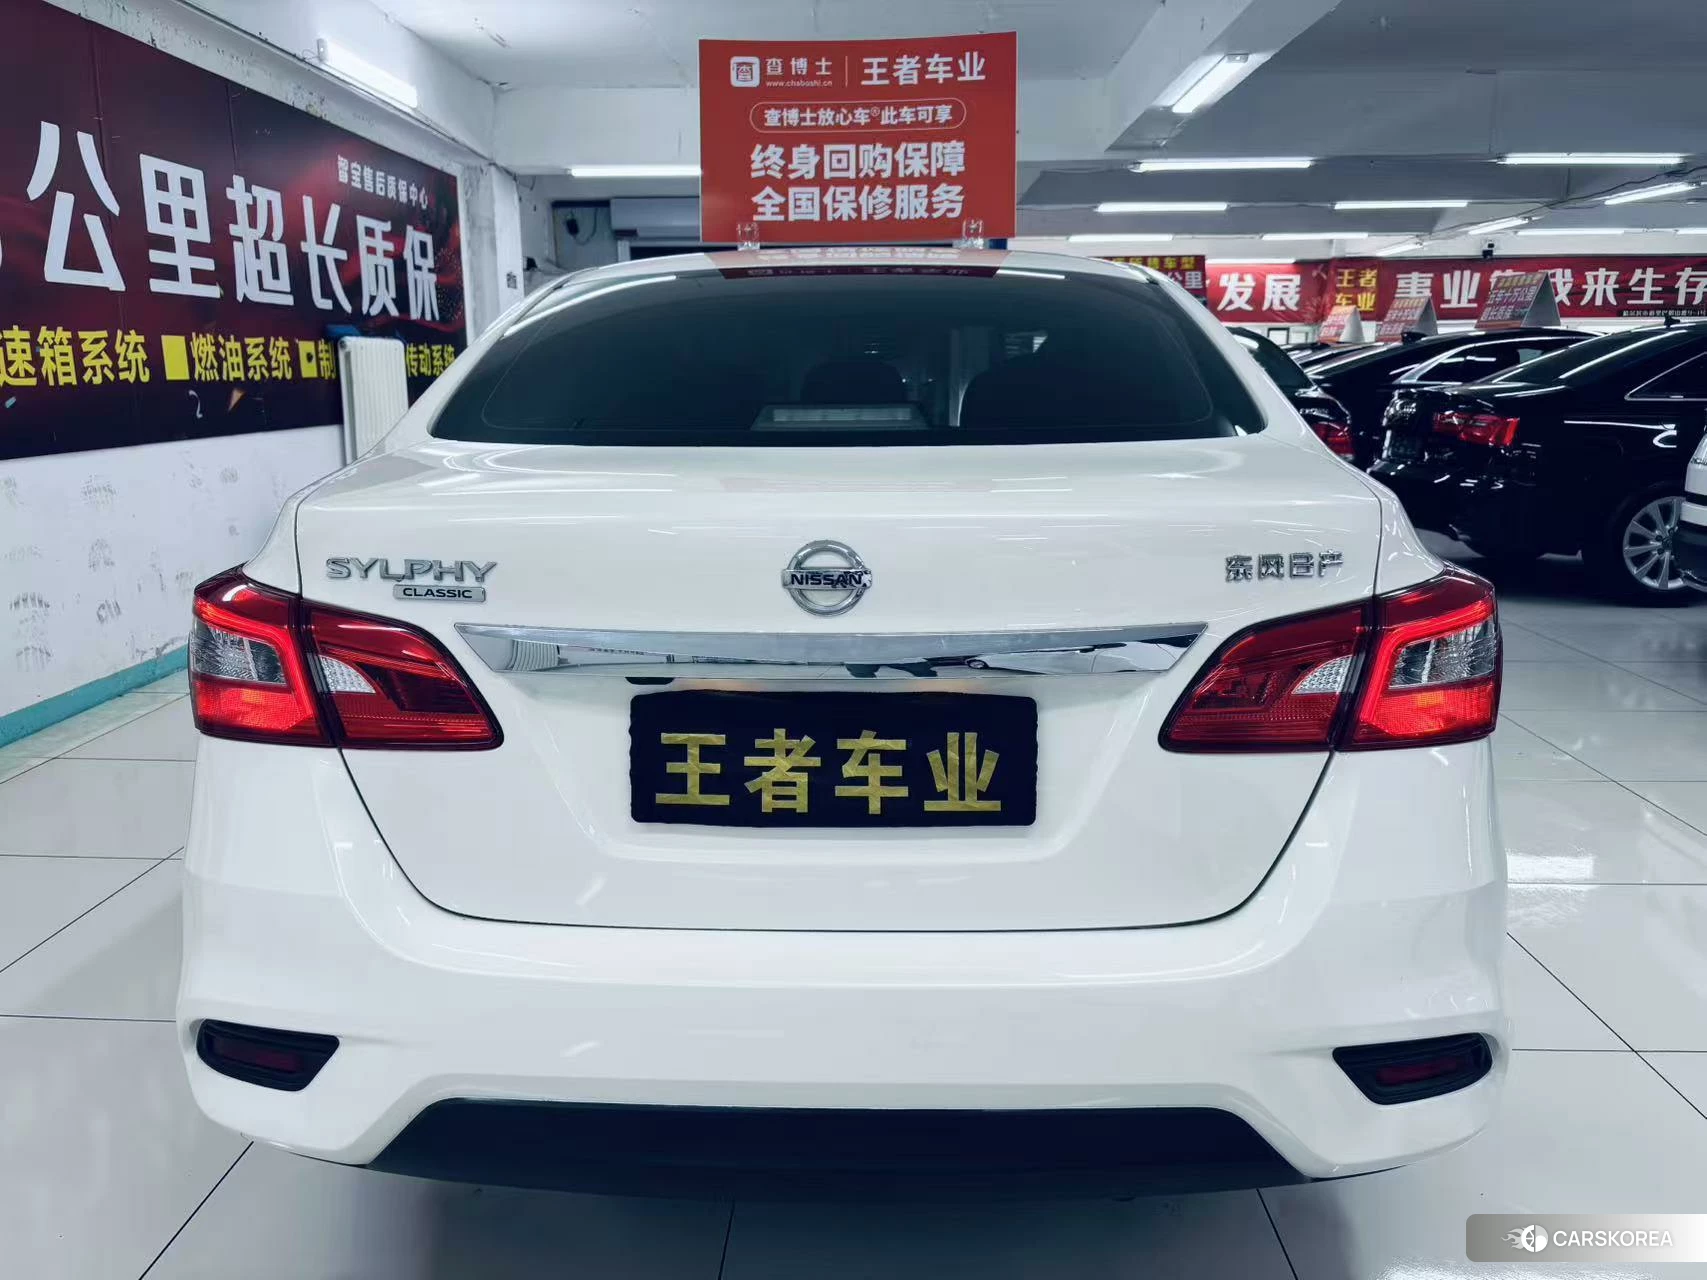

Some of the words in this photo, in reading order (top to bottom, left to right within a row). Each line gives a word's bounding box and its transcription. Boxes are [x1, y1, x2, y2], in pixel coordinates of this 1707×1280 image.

[765, 57, 832, 75] 查博士
[860, 51, 986, 86] 王者车业
[750, 140, 966, 180] 终身回购保障
[27, 120, 440, 322] 公里超长质保
[751, 183, 965, 222] 全国保修服务
[1216, 272, 1301, 311] 发展
[1336, 268, 1378, 287] 王者
[1396, 267, 1707, 308] 事业我来生存
[190, 331, 292, 382] 燃油系统
[326, 557, 498, 582] SYLPHY
[790, 573, 863, 586] NISSAN
[1225, 549, 1343, 582] 东风日产
[402, 587, 473, 598] CLASSIC
[655, 728, 1001, 815] 王者车业
